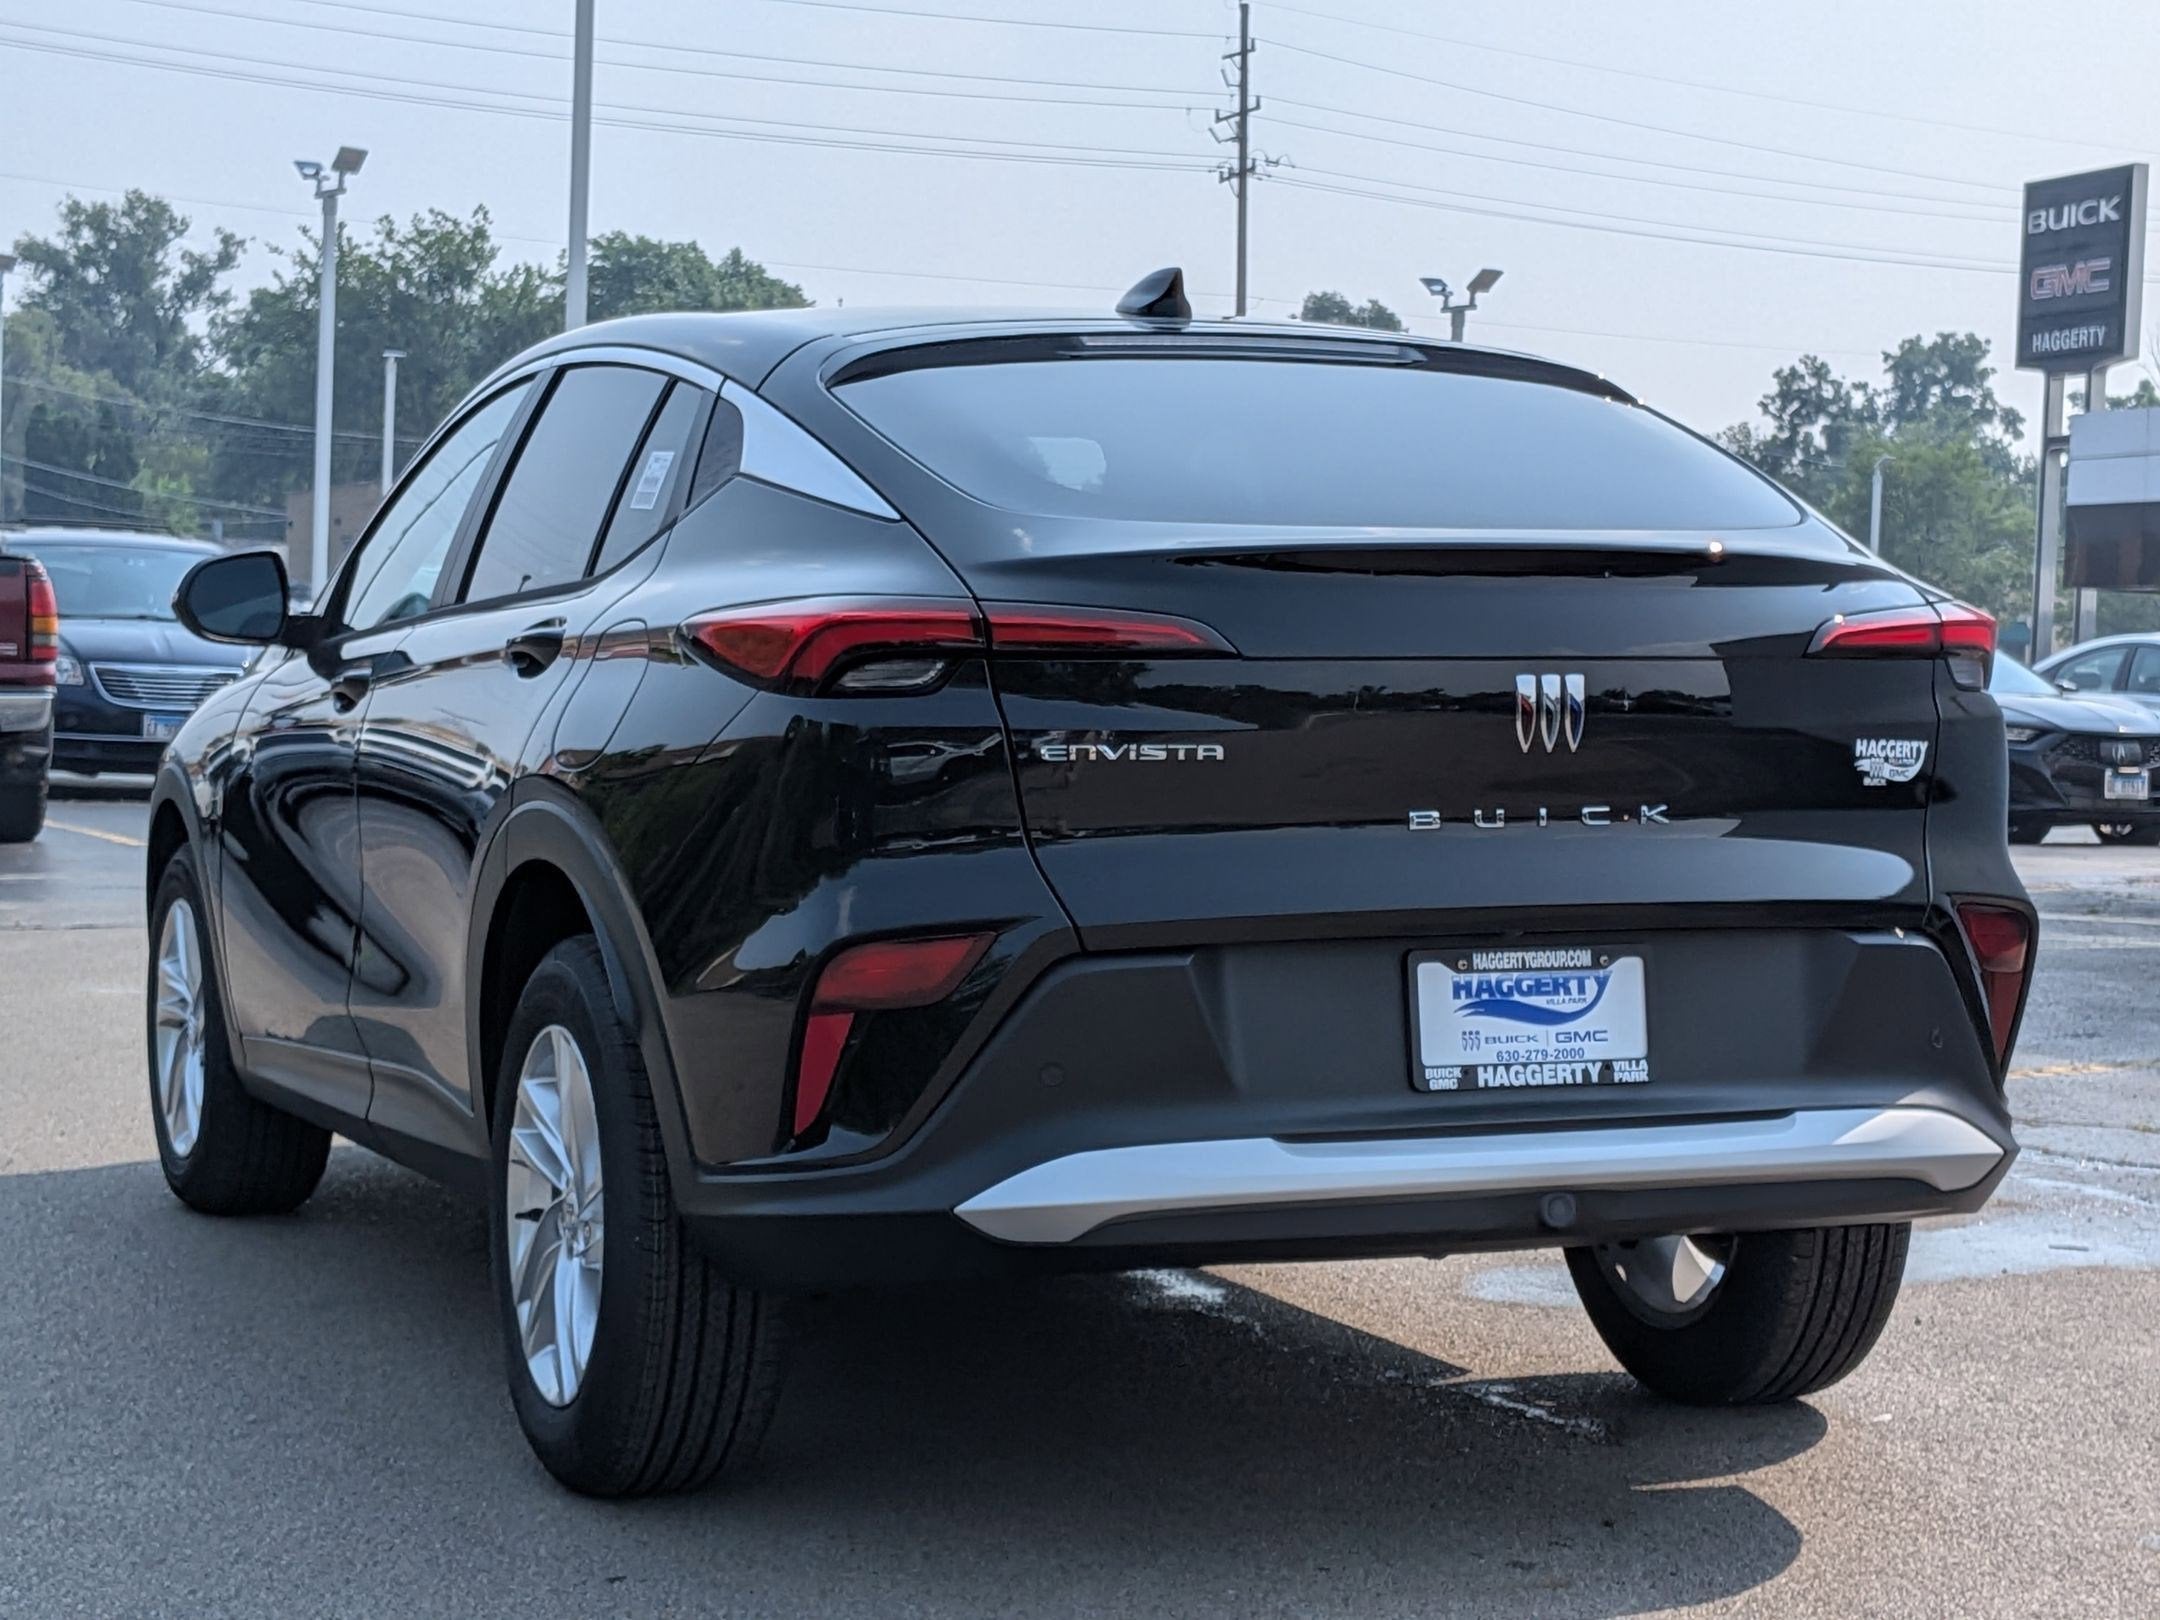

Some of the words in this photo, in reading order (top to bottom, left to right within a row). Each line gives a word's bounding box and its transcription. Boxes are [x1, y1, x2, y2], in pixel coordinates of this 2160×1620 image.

[2028, 195, 2121, 234] BUICK
[2031, 258, 2111, 300] GMC
[2032, 325, 2105, 352] HAGGERTY
[1040, 744, 1225, 762] ENVISTA
[1855, 739, 1928, 758] HAGGERTY
[1408, 804, 1669, 831] BUICK
[1473, 949, 1592, 970] HAGGERTYGROUP.COM
[1452, 971, 1613, 1000] HAGGERTY
[1484, 1033, 1539, 1046] BUICK
[1555, 1030, 1608, 1043] GMC
[1496, 1047, 1585, 1062] 630-279-2000
[1425, 1067, 1462, 1080] BUICK
[1477, 1061, 1603, 1088] HAGGERTY
[1612, 1059, 1649, 1071] VILLA
[1429, 1078, 1458, 1090] GMC
[1613, 1071, 1650, 1083] PARK
